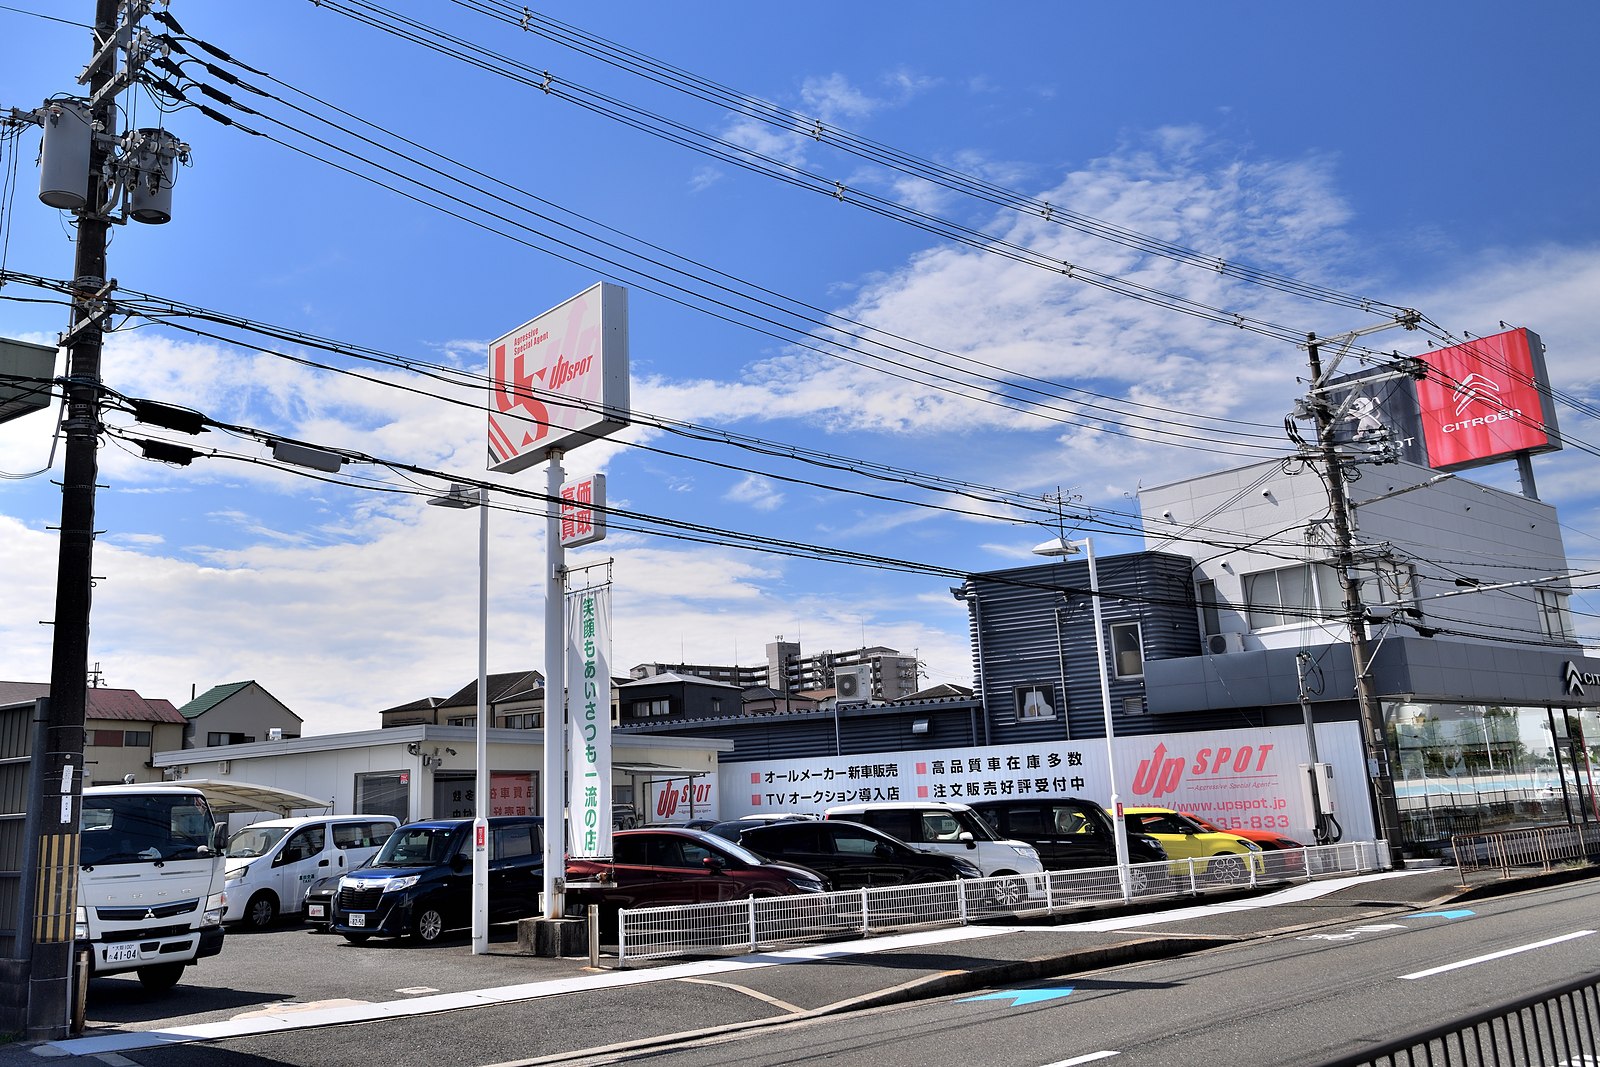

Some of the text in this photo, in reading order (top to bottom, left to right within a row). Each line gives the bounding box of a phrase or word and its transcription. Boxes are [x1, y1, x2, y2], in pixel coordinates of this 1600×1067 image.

[514, 331, 549, 356] Special Agent
[582, 597, 598, 851] 笑顔もあいさつも一流の店
[932, 751, 1083, 775] 高品質車在庫多数
[1191, 744, 1274, 775] SPOT
[764, 763, 898, 784] オールメーカー新車販売
[933, 776, 1085, 798] 注文販売好評受付中
[1208, 815, 1289, 829] 35-833
[113, 949, 137, 961] 41-04
